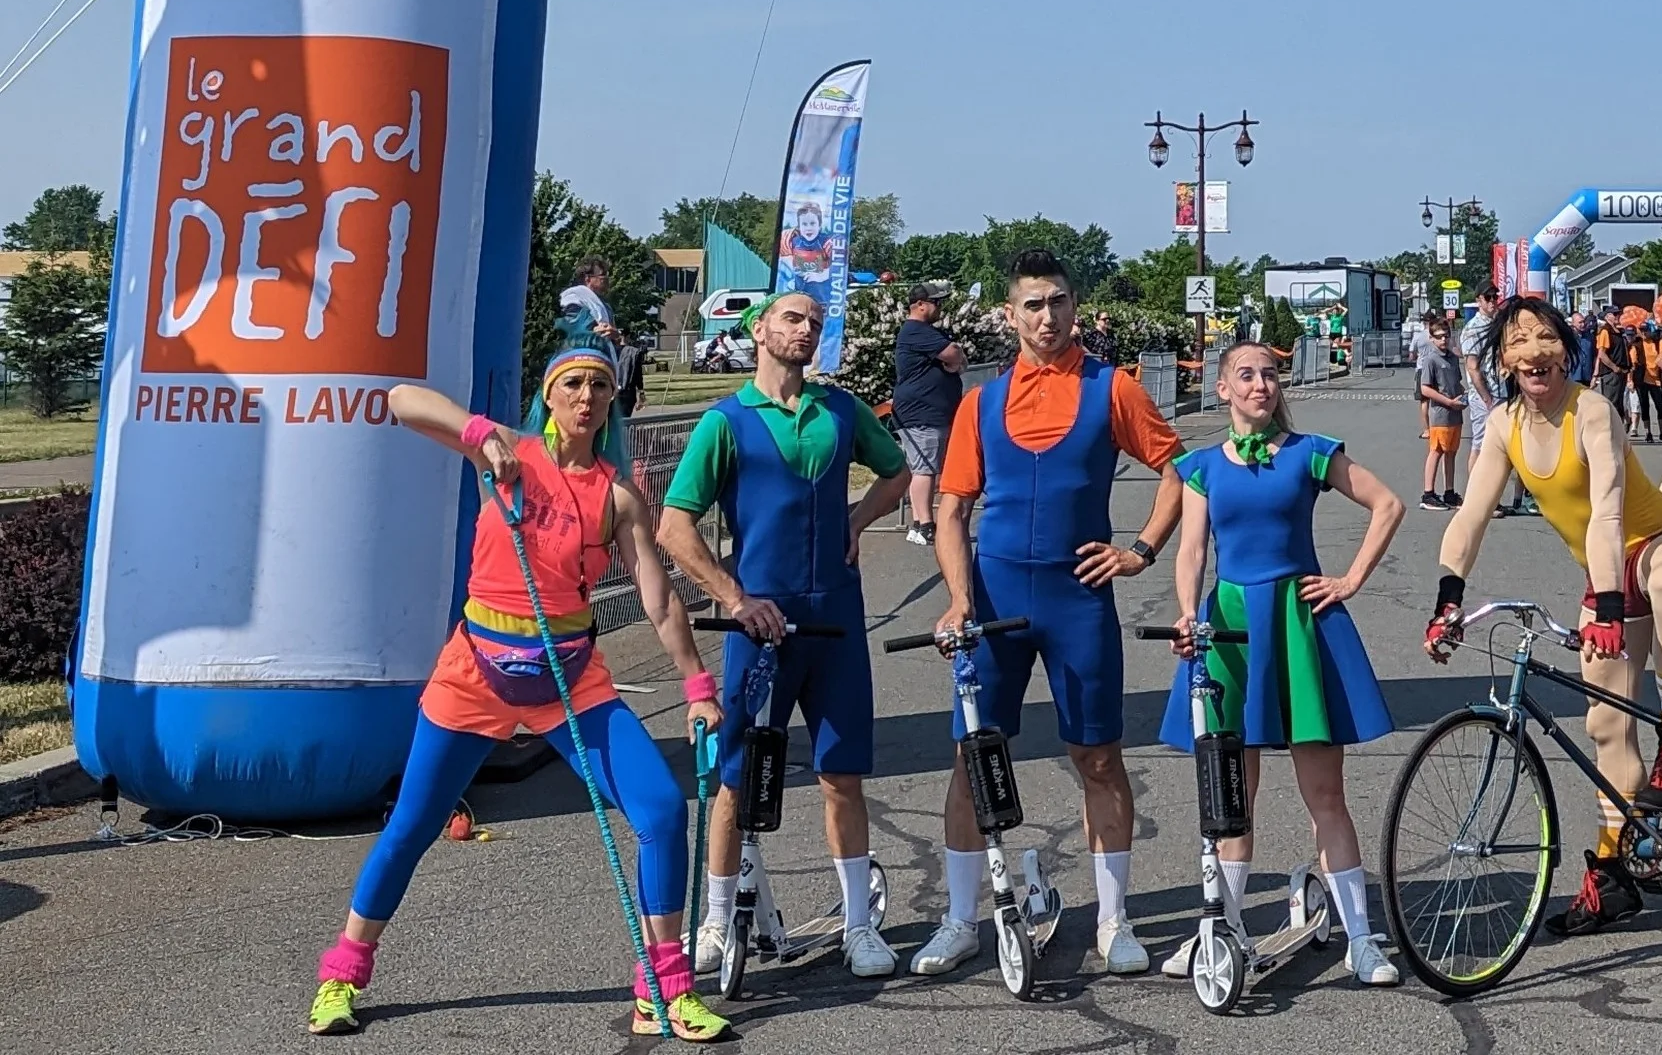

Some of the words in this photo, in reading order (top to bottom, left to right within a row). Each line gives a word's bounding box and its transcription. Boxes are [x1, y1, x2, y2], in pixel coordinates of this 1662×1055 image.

[187, 57, 224, 101] le
[179, 90, 421, 191] grand
[834, 176, 851, 206] VIE
[832, 209, 848, 234] DE
[1543, 225, 1580, 238] Saputo
[1445, 296, 1457, 306] 30
[135, 385, 264, 425] PIERRE
[284, 386, 402, 427] LAVO
[760, 755, 774, 803] W-KING
[989, 754, 1007, 801] W-KING
[1229, 757, 1240, 810] W-KING
